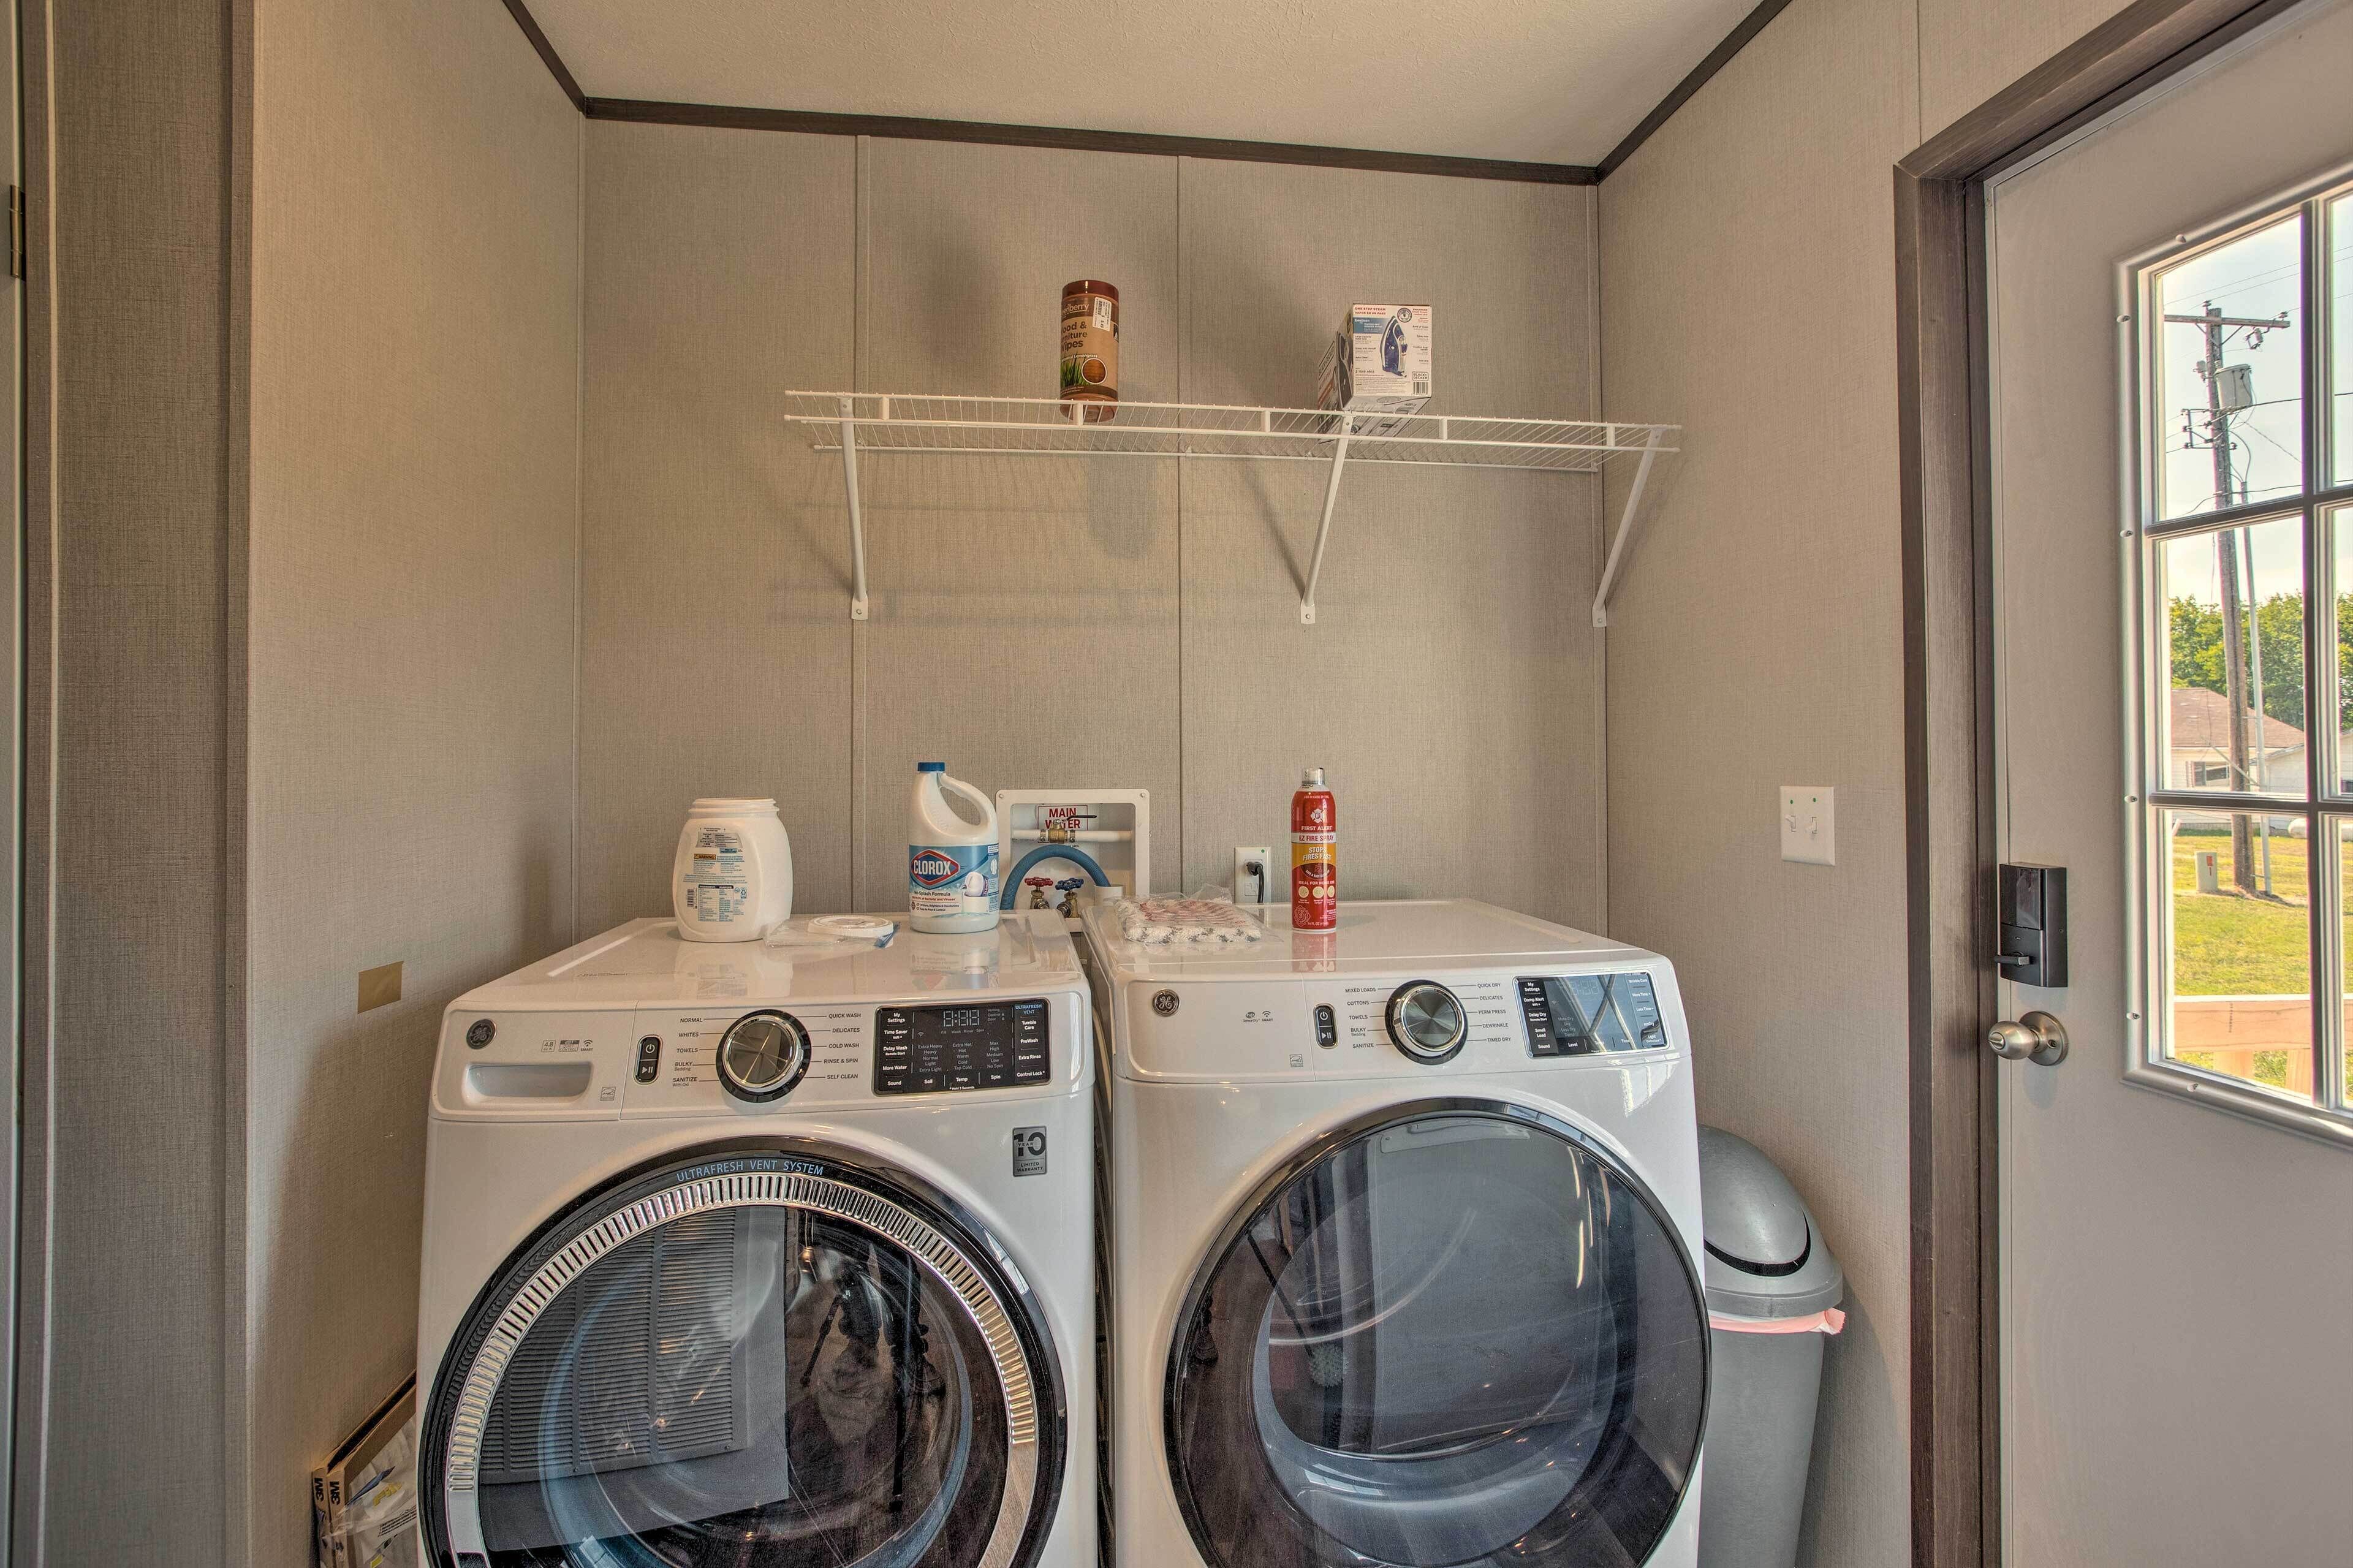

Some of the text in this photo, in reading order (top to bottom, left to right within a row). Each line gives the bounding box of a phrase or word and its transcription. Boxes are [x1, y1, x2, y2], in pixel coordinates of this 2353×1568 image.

[1062, 322, 1077, 334] ood
[1049, 808, 1076, 817] MAIN
[914, 860, 950, 875] CLOROX
[1014, 1132, 1045, 1156] 10
[676, 1160, 824, 1182] ULTRAFRESH VENT SYSTEM
[314, 1477, 324, 1501] 3M
[330, 1481, 340, 1505] 3M
